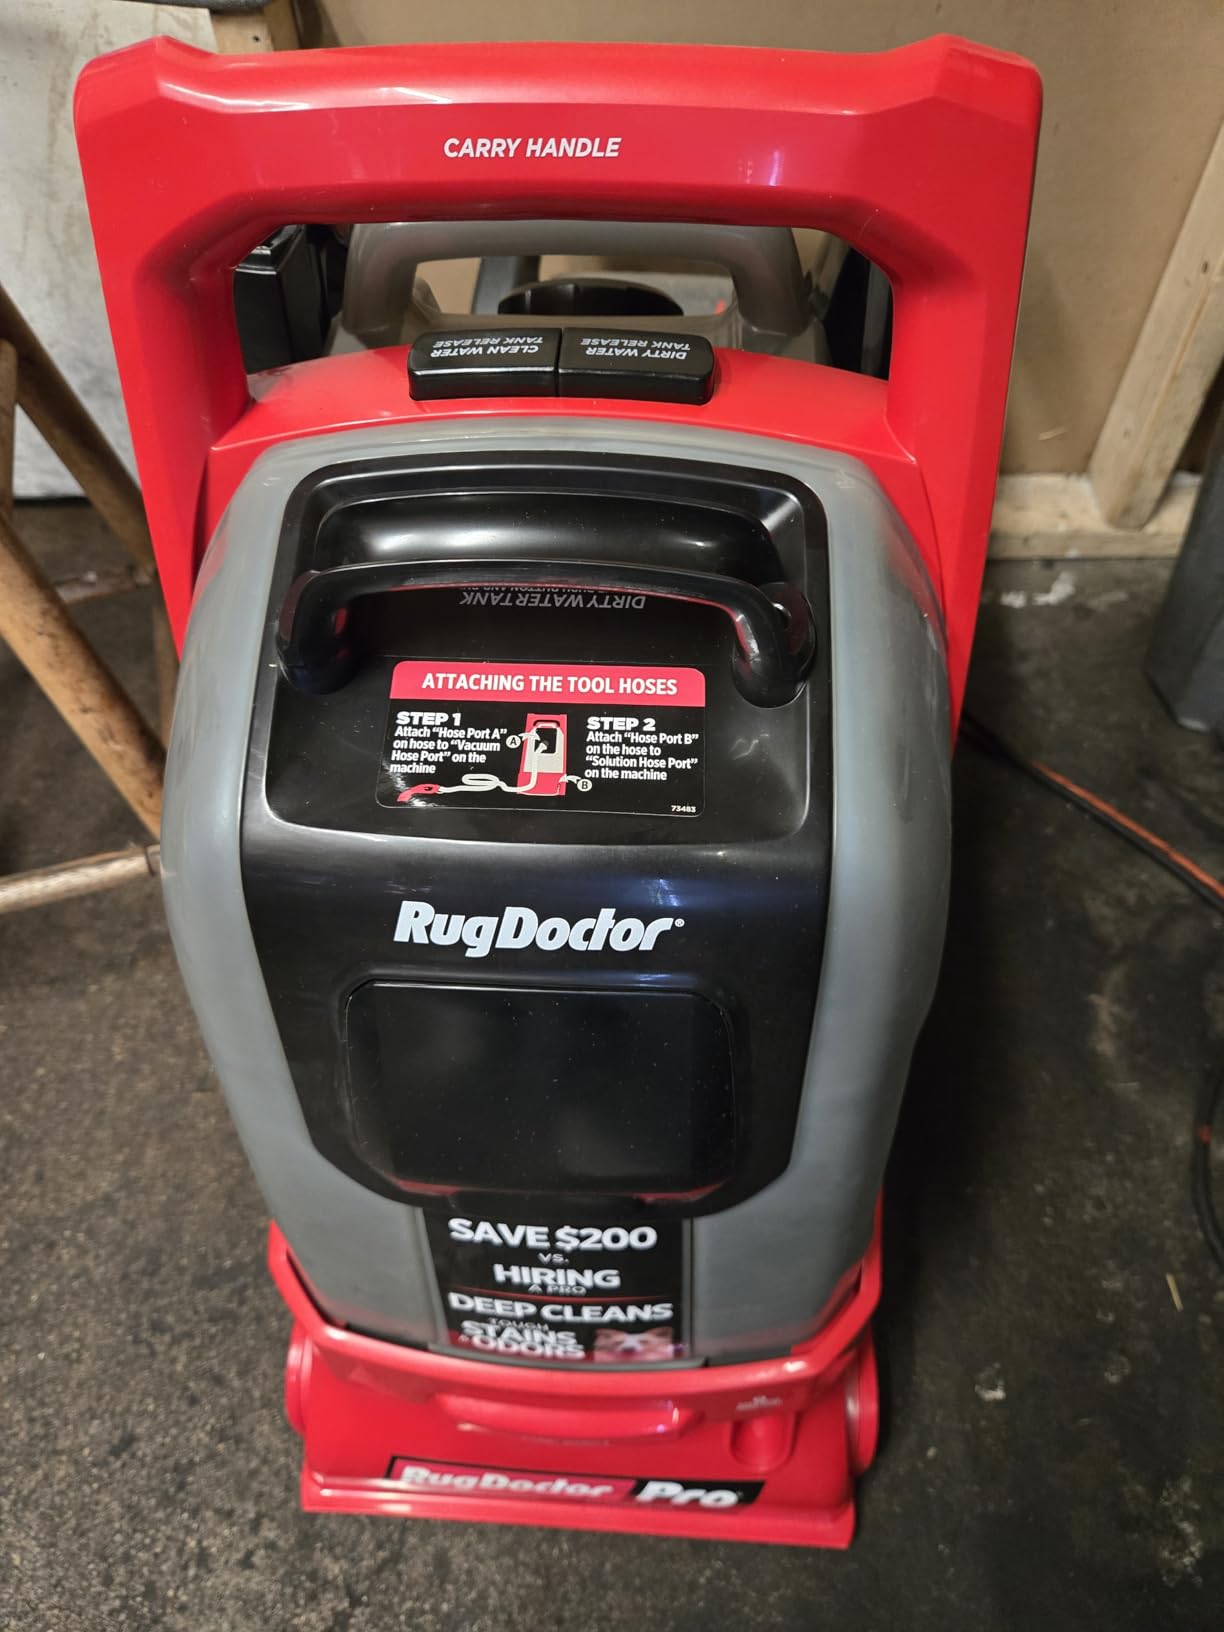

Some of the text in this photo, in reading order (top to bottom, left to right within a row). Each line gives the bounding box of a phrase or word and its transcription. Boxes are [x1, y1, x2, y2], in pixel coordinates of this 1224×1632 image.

[443, 137, 622, 158] CARRY HANDLE
[432, 336, 543, 348] TANK RELEASE
[580, 338, 691, 350] TANK RELEASE
[430, 345, 539, 357] CLEAN WATER
[585, 346, 687, 360] DIRTY WATER
[459, 591, 646, 609] DIRTY WATER TANK
[421, 673, 678, 695] ATTACHING THE TOOL HOSES
[396, 711, 461, 726] STEP 1
[586, 716, 656, 731] STEP 2
[394, 727, 430, 738] Attach
[467, 728, 490, 739] Port
[586, 731, 622, 743] Attach
[659, 733, 683, 744] Port
[393, 740, 408, 749] on
[409, 738, 436, 750] hose
[436, 739, 449, 750] to
[586, 744, 661, 756] on the hose to
[391, 750, 418, 762] Hose
[452, 753, 467, 763] on
[468, 752, 486, 763] the
[638, 757, 666, 768] Hose
[390, 763, 436, 774] machine
[584, 768, 667, 781] on the machine
[448, 1217, 658, 1252] SAVE $200
[493, 1263, 622, 1289] HIRING
[546, 1284, 587, 1296] PRO
[448, 1292, 674, 1323] DEEP CLEANS
[461, 1320, 578, 1345] STAINS
[471, 1335, 586, 1360] ODORS
[635, 1480, 739, 1509] Pro
